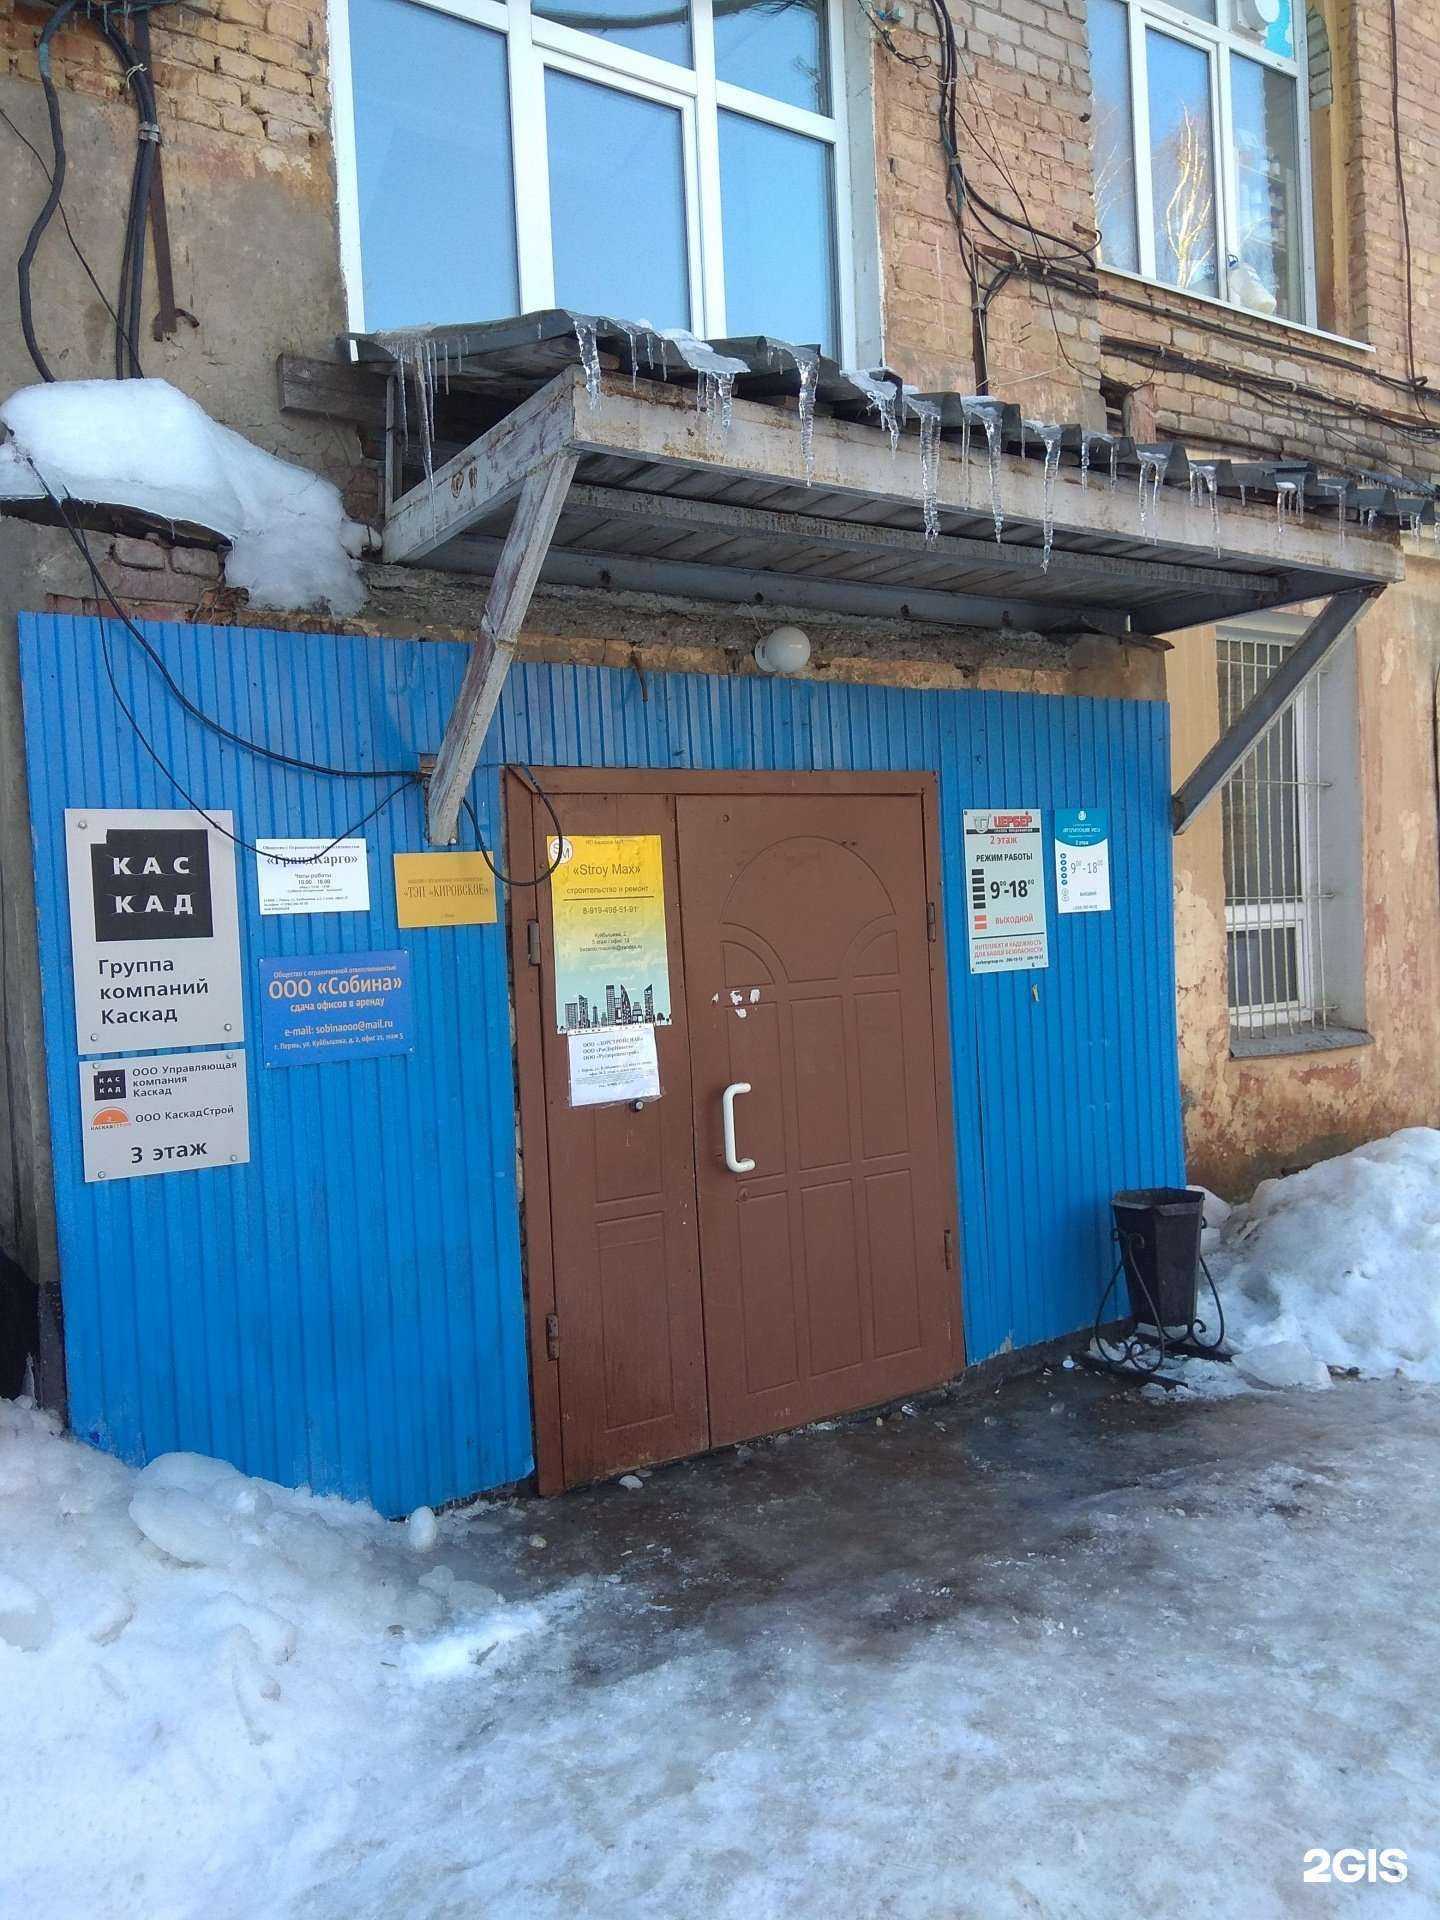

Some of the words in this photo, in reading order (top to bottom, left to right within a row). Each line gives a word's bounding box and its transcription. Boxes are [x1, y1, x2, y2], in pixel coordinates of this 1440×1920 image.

[994, 816, 1032, 828] ЦЕРБЕР
[990, 836, 995, 844] 2
[996, 836, 1018, 844] этаж
[976, 854, 1003, 862] РЕЖИМ
[1004, 852, 1033, 861] РАБОТЫ
[573, 864, 609, 877] «Stroy
[612, 863, 641, 874] Max»
[566, 886, 617, 895] строительство
[624, 886, 649, 894] ремонт
[996, 913, 1034, 924] ВЫХОДНОЙ
[98, 959, 174, 978] Группа
[100, 978, 208, 1000] компаний
[268, 978, 312, 999] ООО
[317, 974, 402, 995] «Собина»
[290, 1002, 315, 1014] сдача
[316, 1001, 347, 1012] офисов
[356, 997, 385, 1008] аренду
[101, 1008, 178, 1024] Каскад
[284, 1026, 314, 1037] e-mail:
[132, 1066, 158, 1076] ООО
[162, 1062, 237, 1075] Управляющая
[132, 1076, 188, 1088] компания
[133, 1088, 172, 1098] Каскад
[136, 1112, 161, 1123] ООО
[165, 1105, 234, 1120] КаскадСтрой
[130, 1146, 142, 1164] 3
[152, 1142, 208, 1161] этаж
